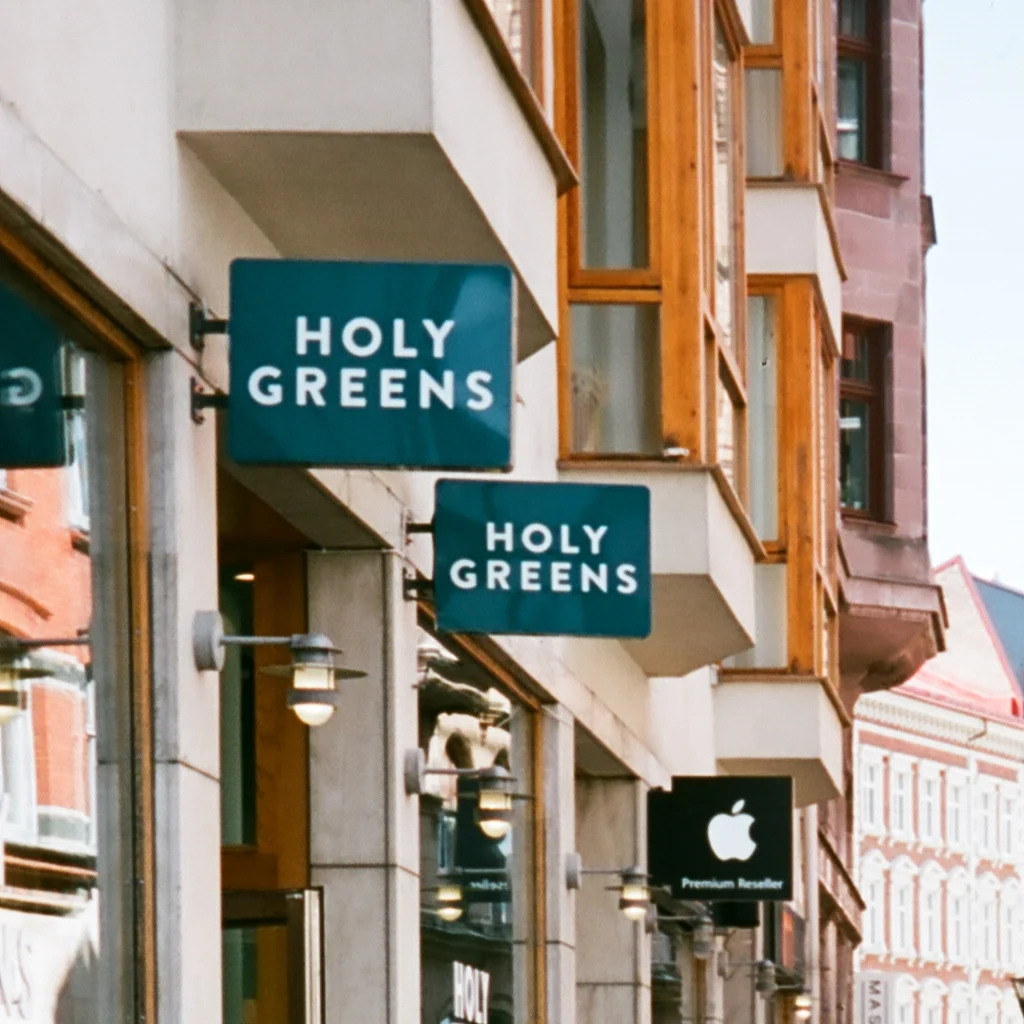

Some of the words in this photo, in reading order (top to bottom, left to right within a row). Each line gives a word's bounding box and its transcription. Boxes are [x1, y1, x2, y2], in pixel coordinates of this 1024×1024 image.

[296, 316, 455, 358] HOLY
[247, 365, 494, 411] GREENS
[486, 521, 608, 555] HOLY
[450, 558, 638, 594] GREENS
[682, 877, 735, 889] Premium
[737, 877, 783, 889] Reseller
